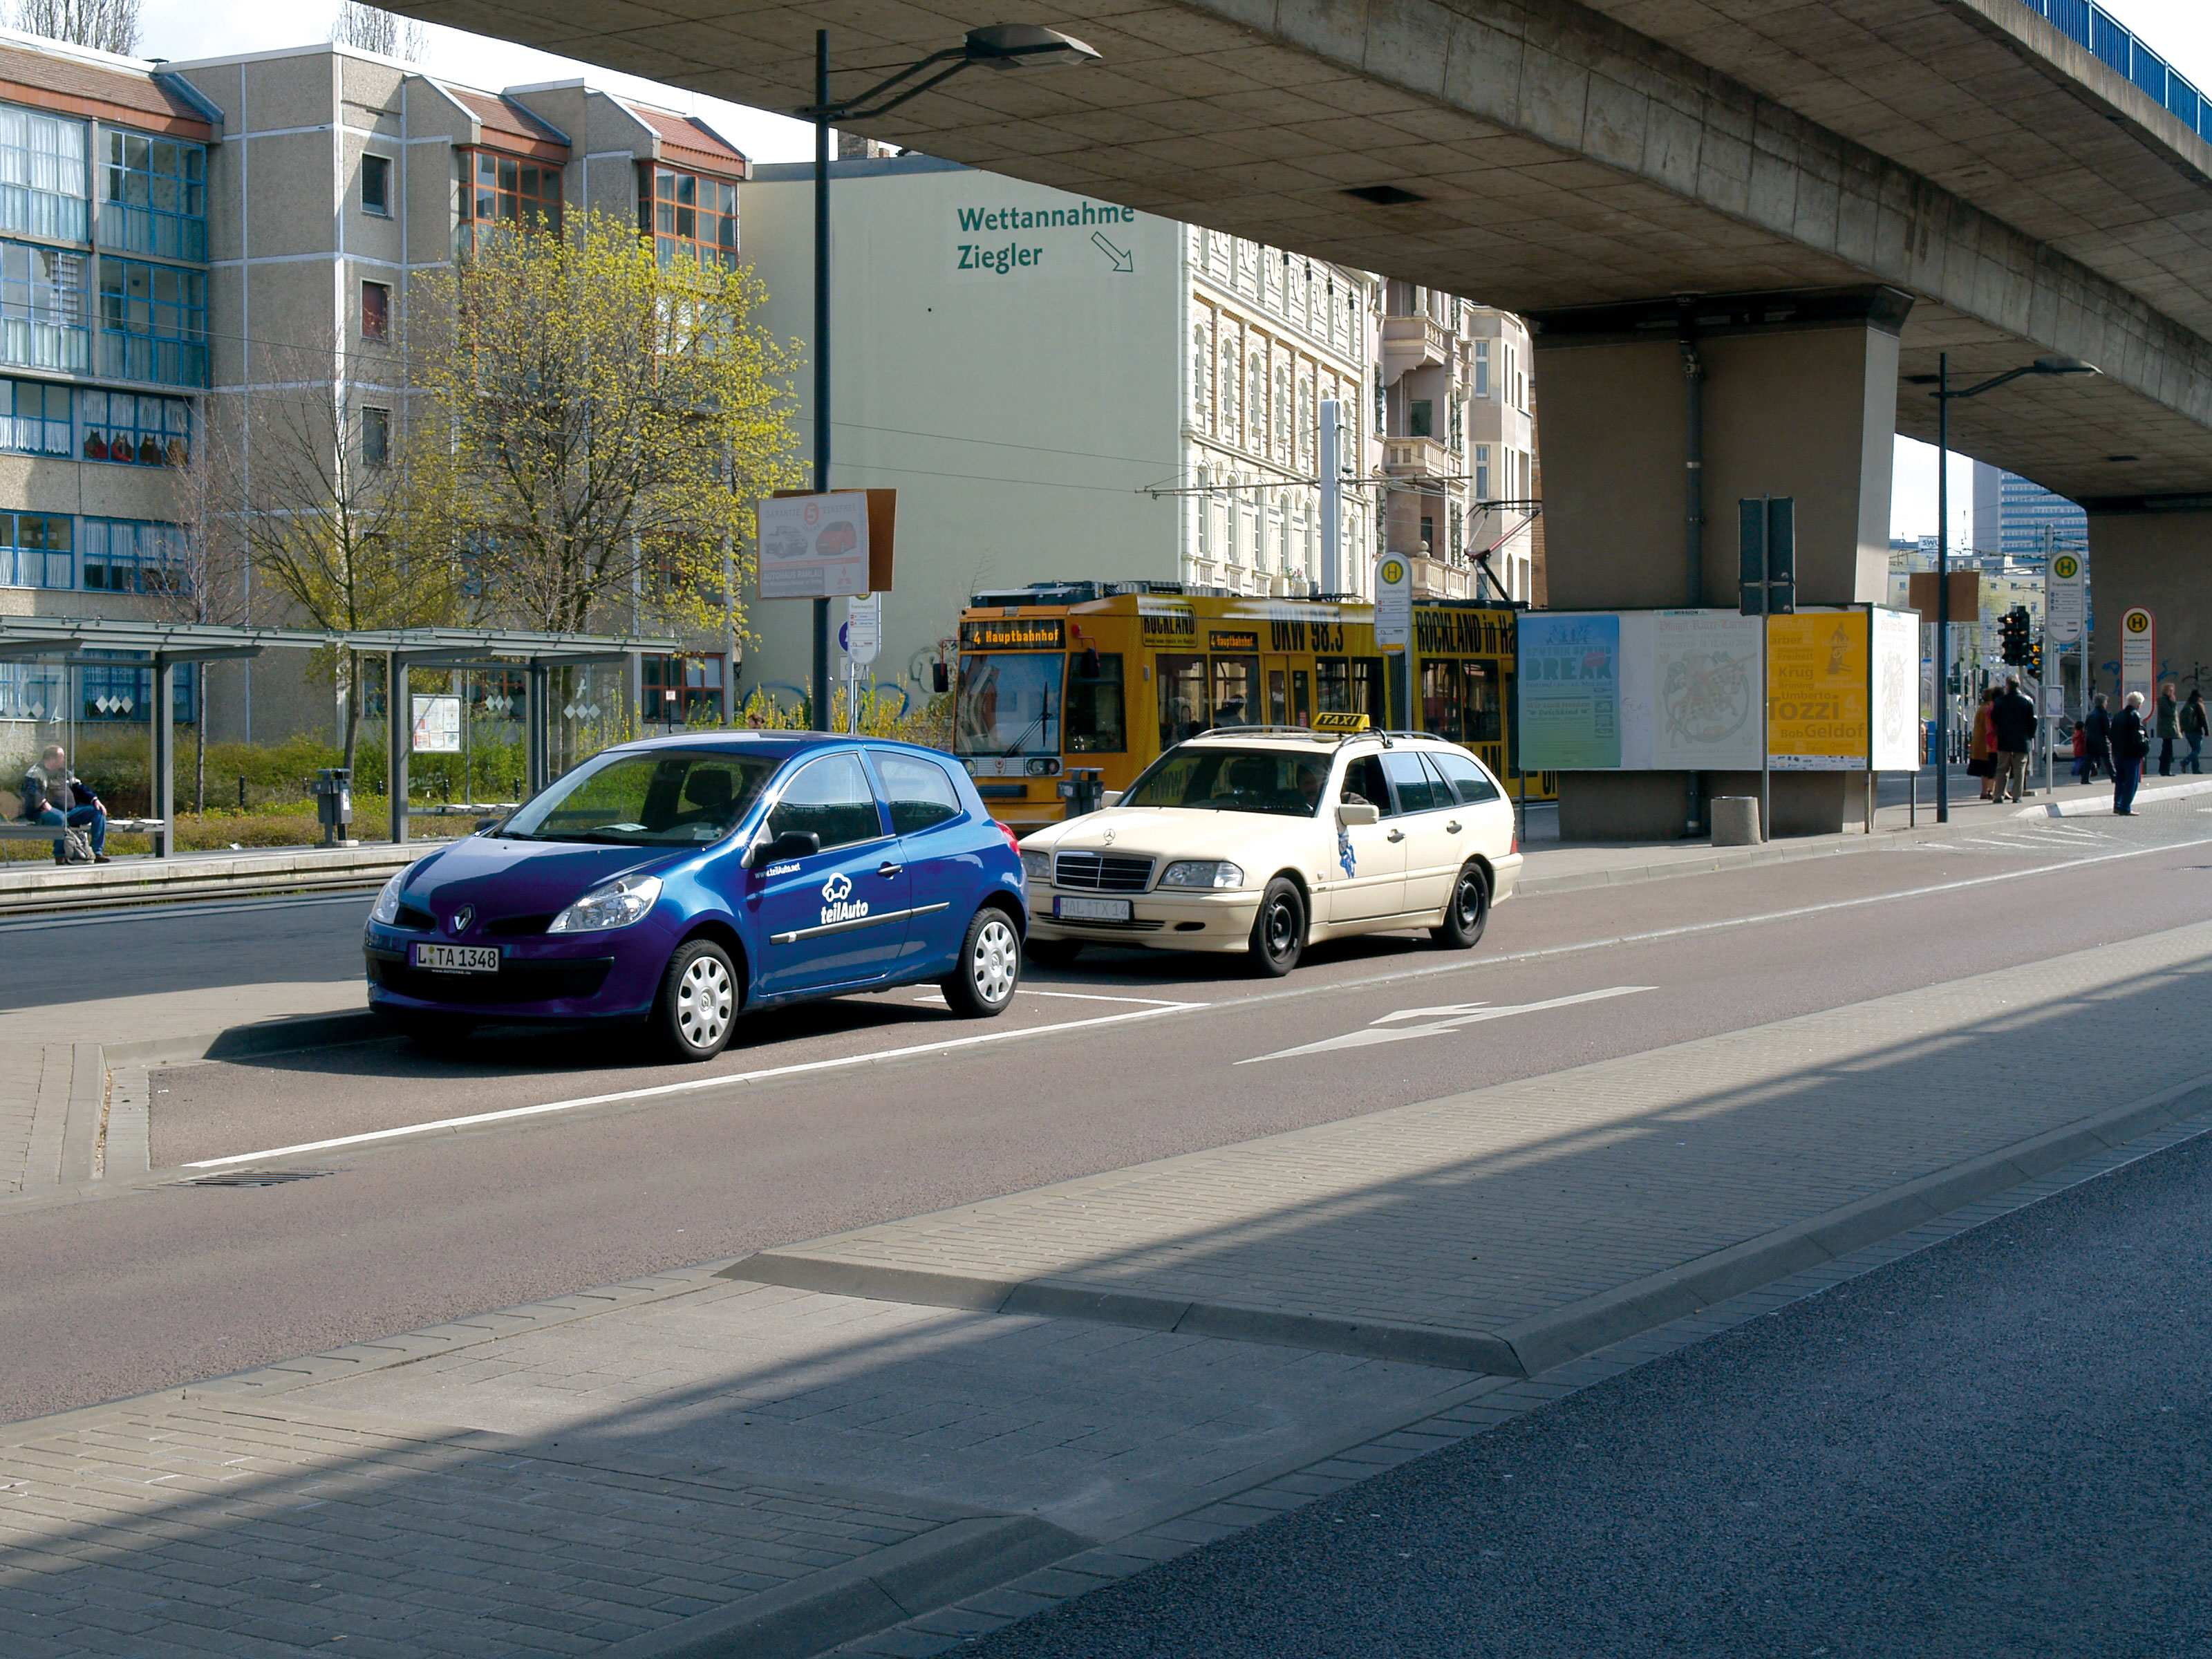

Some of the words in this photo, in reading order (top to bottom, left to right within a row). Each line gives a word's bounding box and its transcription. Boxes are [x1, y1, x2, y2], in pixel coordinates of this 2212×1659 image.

[957, 201, 1134, 232] Wettannahme
[957, 243, 1042, 274] Ziegler
[1144, 608, 1195, 635] ROCKLAND
[1271, 607, 1305, 651] UKW
[1311, 608, 1344, 653] 98.3
[1416, 610, 1482, 653] ROCKLAND
[1482, 615, 1497, 654] in
[973, 630, 981, 645] 4
[986, 628, 1059, 644] Hauptbahnhof
[1210, 635, 1215, 646] 4
[1217, 635, 1253, 647] Hauptbahnhof
[1768, 635, 1803, 646] arber
[1526, 657, 1612, 681] BREAK
[1778, 667, 1815, 680] Krug
[1781, 691, 1832, 701] Umberto
[1768, 695, 1840, 720] Tozzi
[1322, 715, 1358, 725] TAXI
[1780, 729, 1803, 739] Bob
[1804, 722, 1865, 739] Geldof
[821, 899, 869, 924] teilAuto
[1061, 900, 1085, 914] HAL
[1093, 901, 1109, 915] TX
[418, 946, 427, 964] L
[436, 948, 454, 966] TA
[458, 949, 496, 968] 1348
